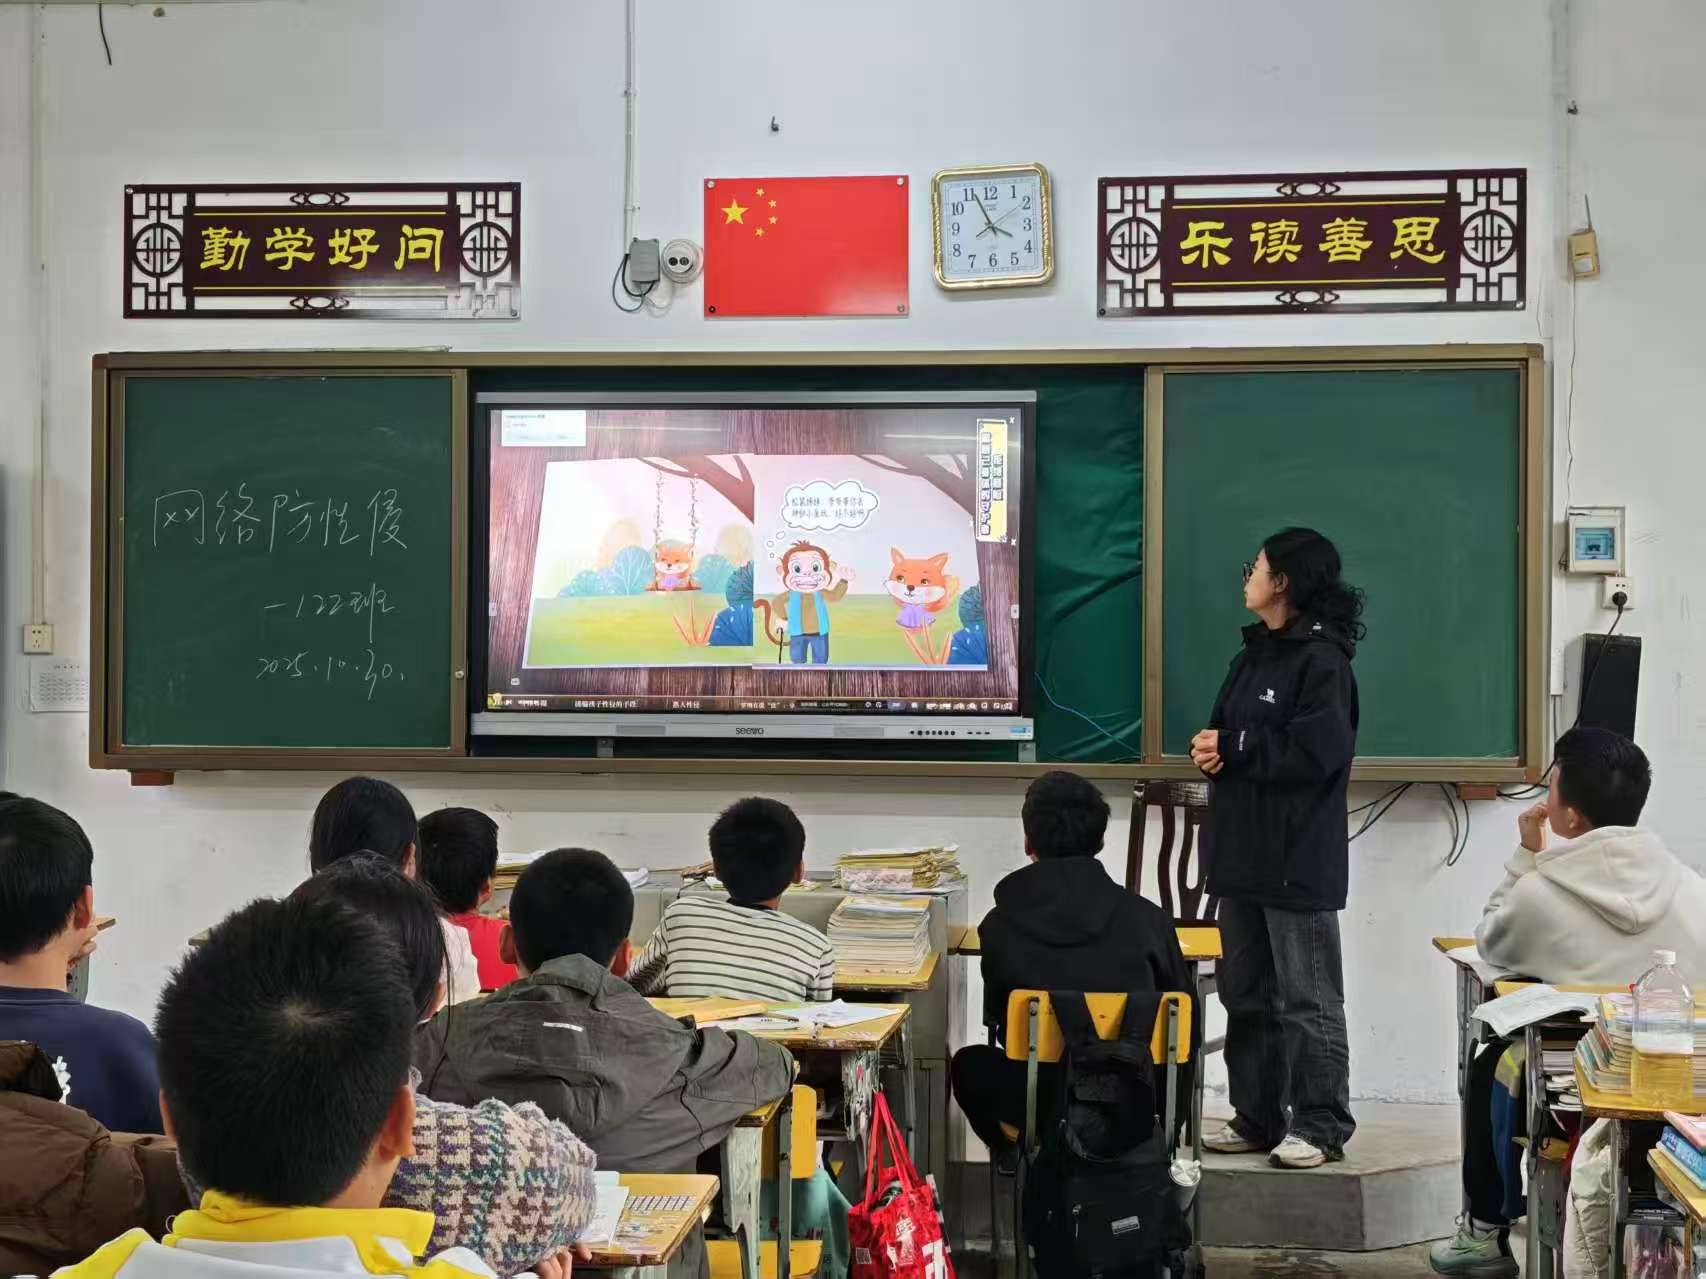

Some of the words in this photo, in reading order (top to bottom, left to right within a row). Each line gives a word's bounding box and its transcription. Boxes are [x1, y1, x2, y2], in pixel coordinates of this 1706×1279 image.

[963, 188, 976, 202] 11
[983, 186, 998, 200] 12
[1011, 185, 1017, 199] 1
[952, 201, 964, 216] 10
[1022, 196, 1031, 210] 2
[952, 222, 960, 236] 9
[1023, 218, 1032, 231] 3
[199, 224, 444, 273] 勤学好问
[1024, 239, 1032, 253] 4
[1179, 216, 1446, 270] 乐读善思
[952, 244, 961, 257] 8
[968, 254, 976, 268] 7
[989, 253, 997, 267] 6
[1010, 252, 1019, 265] 5
[153, 482, 408, 557] 网络防性侵
